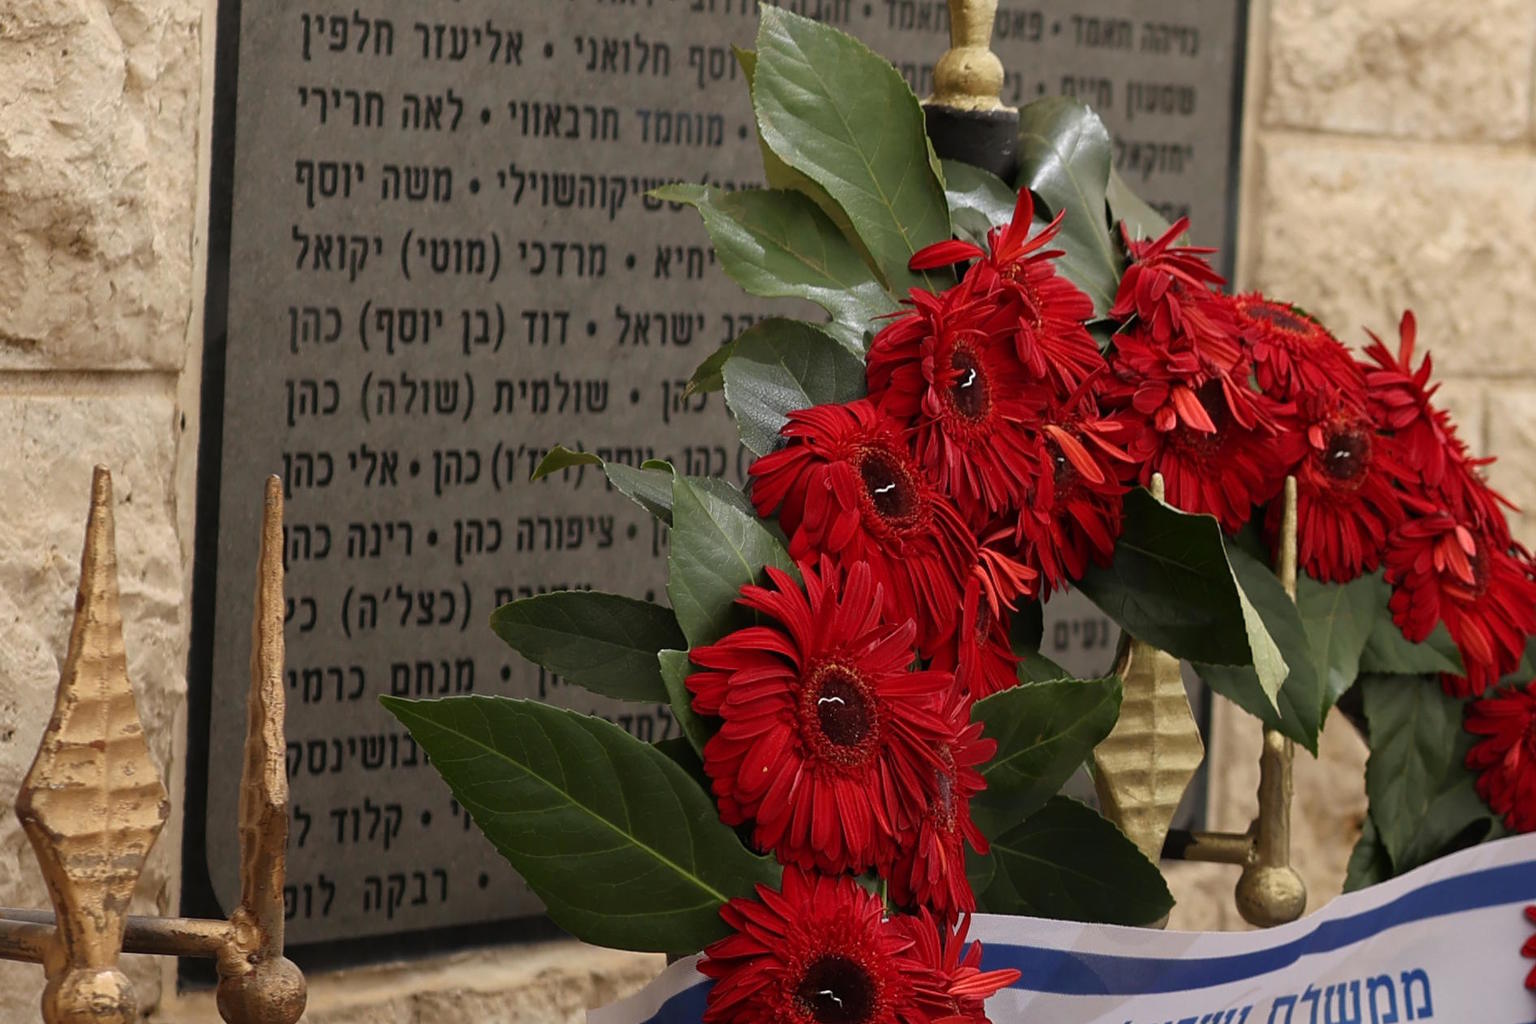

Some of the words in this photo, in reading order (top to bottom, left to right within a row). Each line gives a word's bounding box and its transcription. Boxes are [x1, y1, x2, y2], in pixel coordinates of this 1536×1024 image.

[302, 9, 393, 61] חלפין
[414, 19, 523, 66] אליעזר
[575, 32, 670, 76] חלואני
[689, 46, 736, 89] וסף
[298, 86, 384, 127] חרירי
[402, 88, 463, 131] לאה
[508, 101, 619, 141] חרבאווי
[636, 109, 724, 146] מוחמד
[295, 160, 364, 208] יוסף
[382, 164, 452, 201] משה
[292, 224, 382, 283] יקואל
[401, 228, 500, 282] (מוטי)
[518, 239, 606, 277] מרדכי
[288, 306, 342, 354] כהן
[359, 300, 442, 355] יוסף)
[461, 302, 504, 356] (בן
[522, 310, 570, 346] דוד
[616, 304, 704, 346] ישראל
[286, 379, 339, 427] כהן
[361, 372, 474, 423] (שולה)
[493, 371, 609, 413] שולמית
[283, 453, 334, 499] כהן
[349, 444, 398, 486] אלי
[433, 450, 481, 495] כהן
[283, 524, 331, 573] כהן
[348, 521, 412, 558] רינה
[454, 519, 502, 566] כהן
[516, 515, 613, 551] ציפורה
[391, 657, 474, 697] מנחם
[330, 797, 402, 849] קלוד
[284, 874, 335, 920] לופ
[363, 868, 448, 920] רבקה
